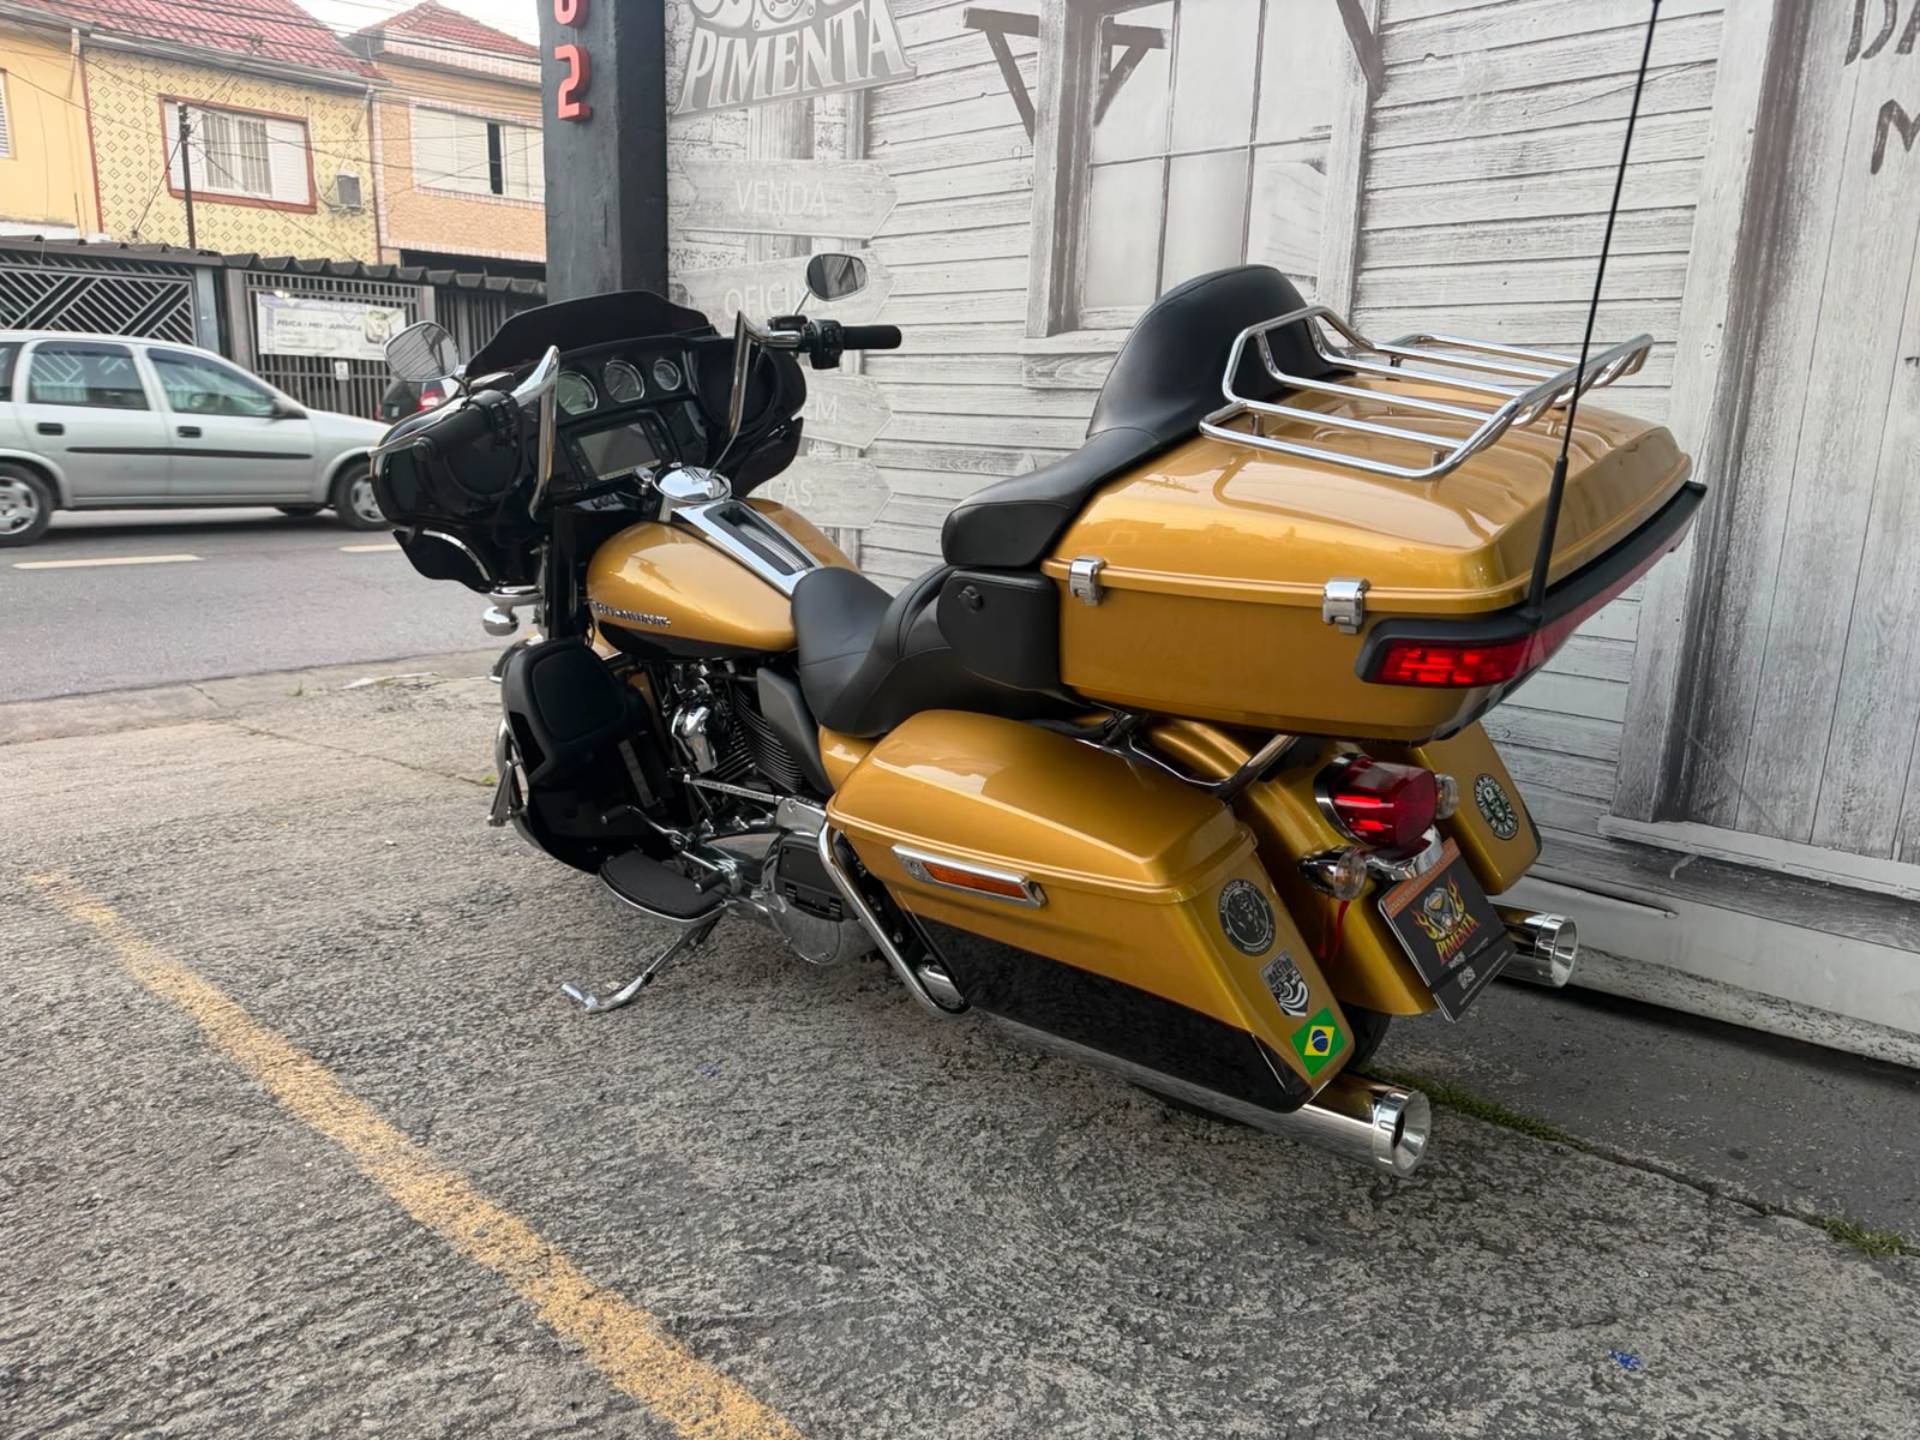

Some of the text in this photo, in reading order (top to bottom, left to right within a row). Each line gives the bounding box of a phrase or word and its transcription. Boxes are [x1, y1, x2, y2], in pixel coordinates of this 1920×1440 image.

[675, 0, 915, 113] PIMENTA
[735, 179, 829, 217] VENDA
[1434, 912, 1481, 965] PIMENTA
